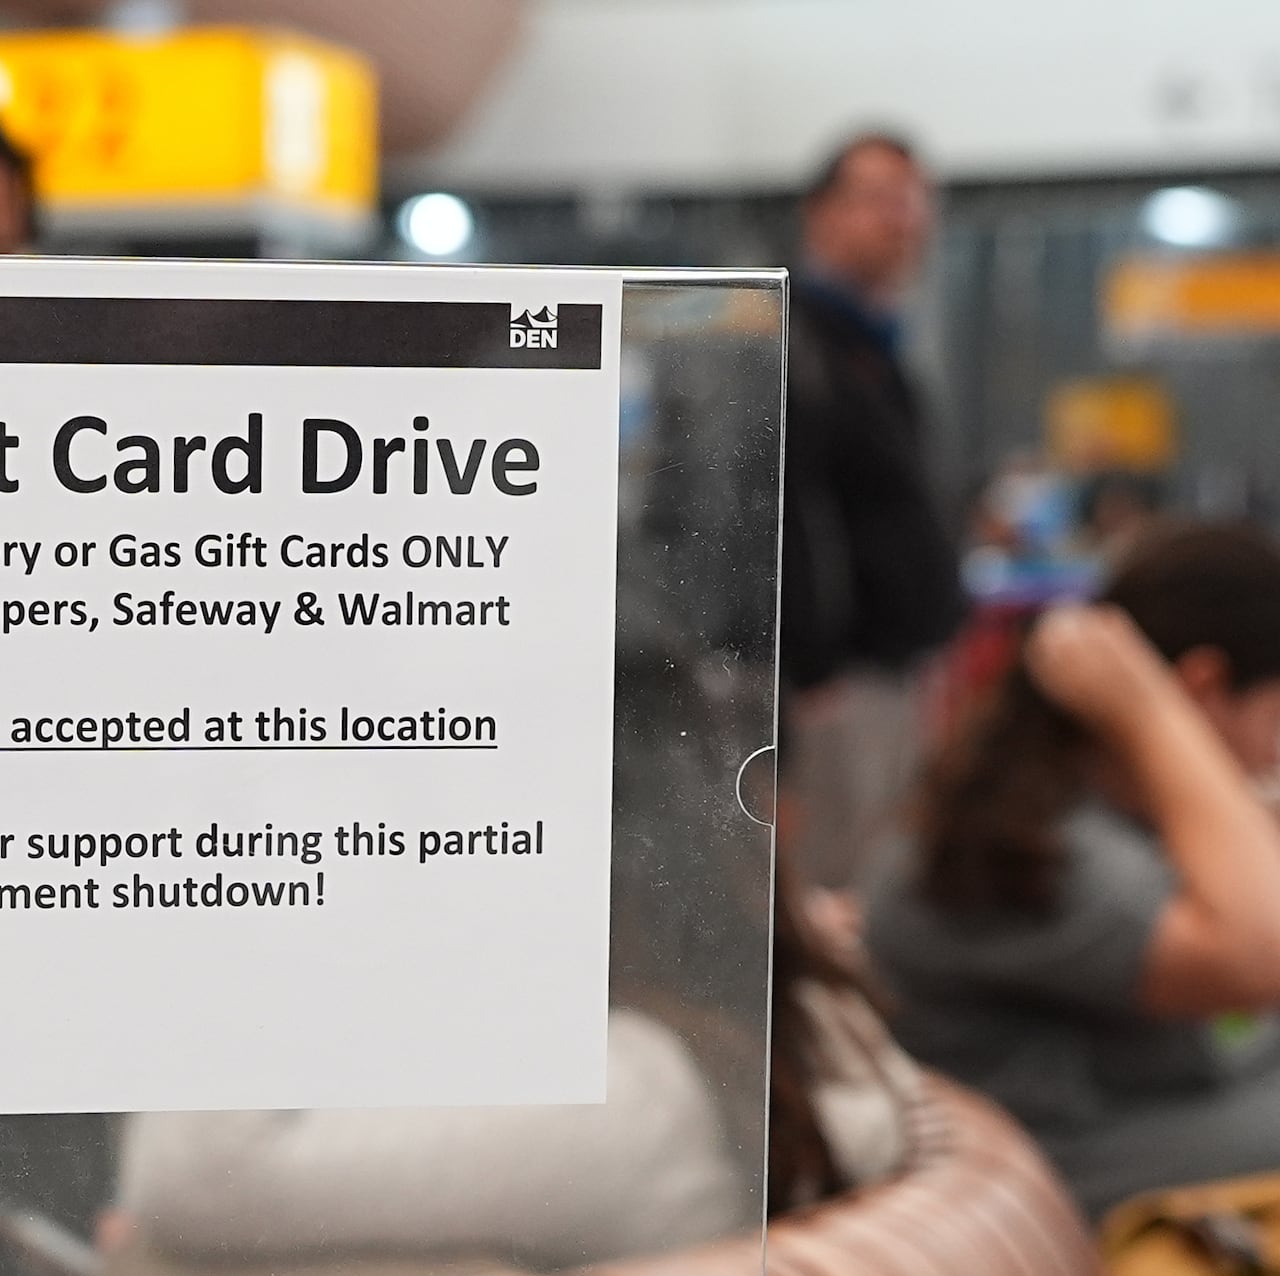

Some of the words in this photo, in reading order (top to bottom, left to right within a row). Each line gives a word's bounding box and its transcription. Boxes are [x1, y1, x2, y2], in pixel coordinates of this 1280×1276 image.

[509, 328, 558, 349] DEN
[53, 413, 262, 494] Card
[303, 416, 539, 496] Drive
[55, 542, 96, 566] or
[110, 534, 180, 567] Gas
[195, 533, 267, 567] Gift
[281, 533, 388, 567] Cards
[403, 536, 509, 567] ONLY
[113, 591, 281, 634] Safeway
[294, 592, 324, 625] &
[338, 592, 509, 625] Walmart
[11, 708, 189, 749] accepted
[205, 712, 242, 742] at
[255, 707, 326, 741] this
[342, 707, 495, 741] location
[28, 828, 182, 866] support
[196, 823, 323, 865] during
[335, 822, 405, 856] this
[420, 821, 542, 863] partial
[113, 872, 323, 908] shutdown!
